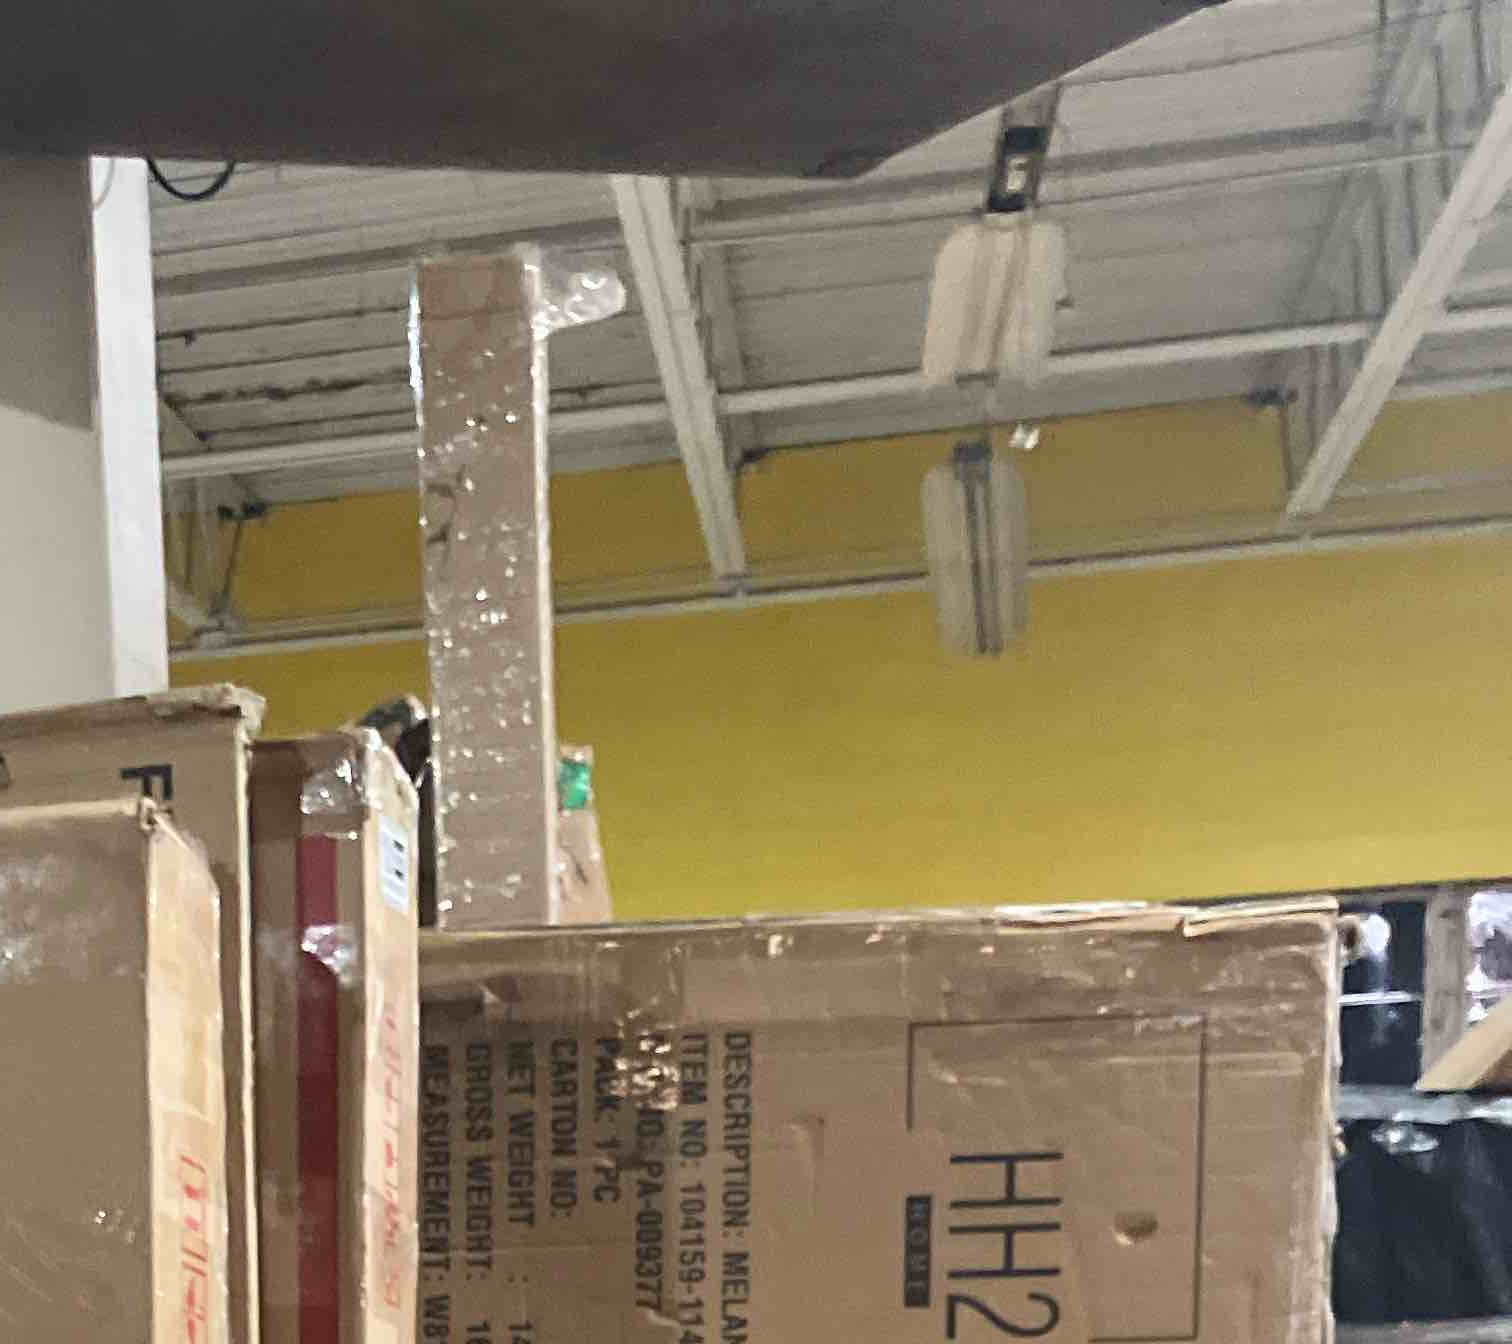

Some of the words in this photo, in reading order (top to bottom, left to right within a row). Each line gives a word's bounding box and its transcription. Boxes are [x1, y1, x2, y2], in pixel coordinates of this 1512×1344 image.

[465, 1042, 494, 1142] GROSS
[507, 1040, 535, 1098] NET
[551, 1037, 579, 1158] CARTON
[679, 1032, 708, 1106] ITEM
[421, 1045, 451, 1282] MEASUREMENT:
[507, 1112, 535, 1227] WEIGHT
[593, 1165, 622, 1204] PC
[679, 1119, 708, 1167] NO:
[721, 1031, 752, 1239] DESCRIPTION:
[465, 1155, 494, 1281] WEIGHT:
[551, 1170, 579, 1221] NO:
